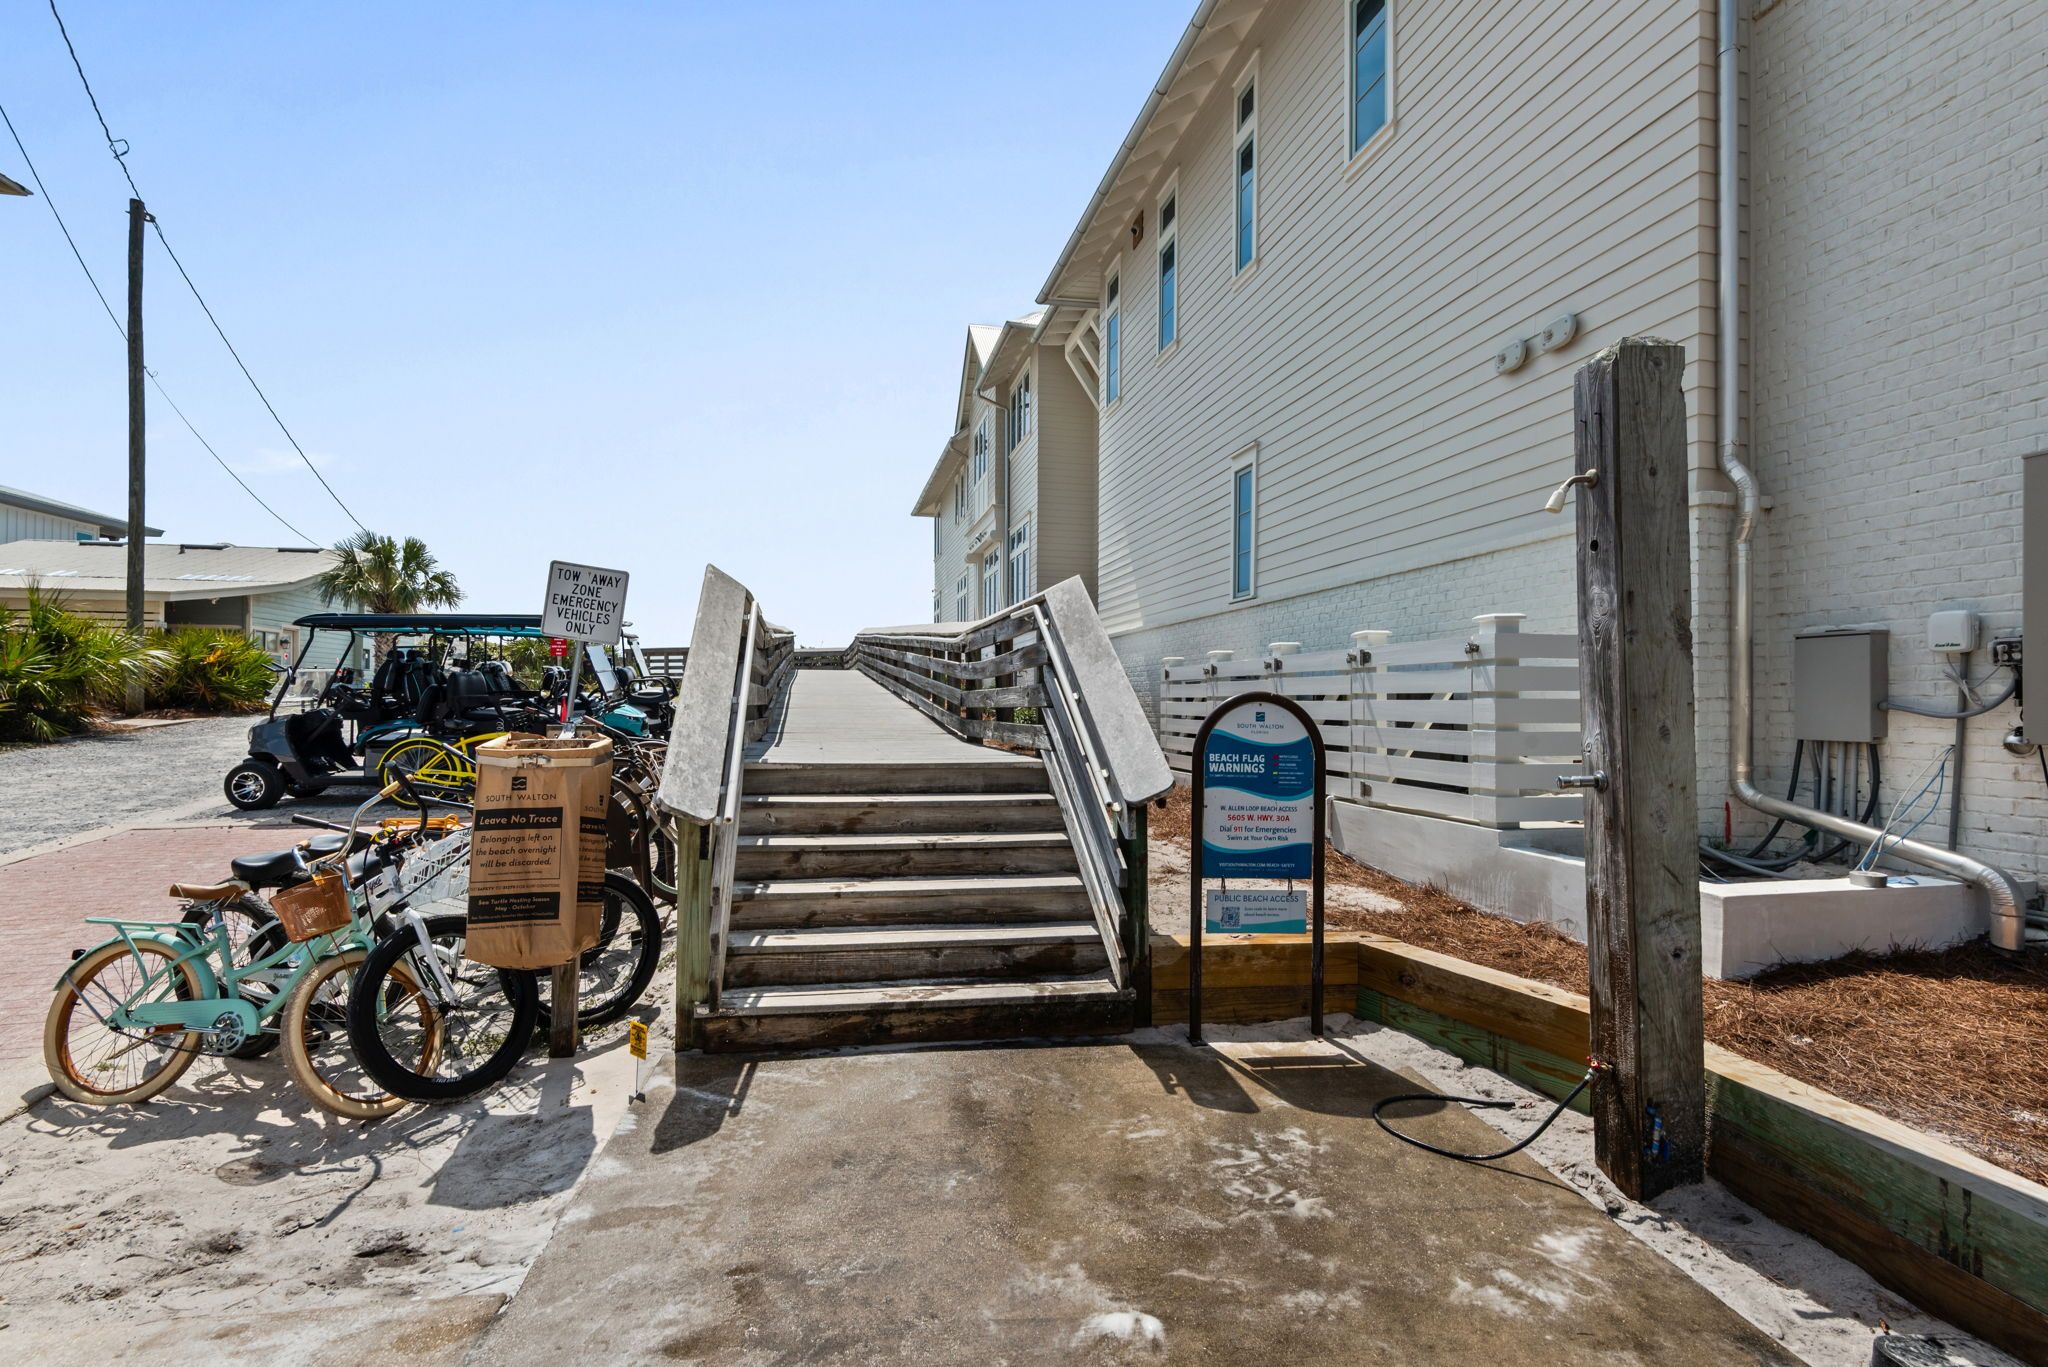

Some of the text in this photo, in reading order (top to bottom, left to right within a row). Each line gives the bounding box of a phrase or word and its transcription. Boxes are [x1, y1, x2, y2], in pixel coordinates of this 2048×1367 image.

[557, 568, 622, 588] TOW AWAY
[572, 583, 602, 598] ZONE
[552, 593, 618, 613] EMERGENCY
[557, 606, 611, 625] VEHICLES
[566, 621, 595, 635] ONLY
[1209, 753, 1265, 763] BEACH FLAG
[1209, 762, 1265, 773] WARNINGS
[486, 793, 557, 803] SOUTH WALTON
[480, 814, 558, 825] Leave No Trace
[1219, 825, 1233, 833] Dial
[1255, 826, 1297, 835] Emergencies
[480, 835, 526, 845] Belongings
[527, 833, 541, 844] left
[476, 844, 557, 857] the beach overnight
[480, 857, 552, 868] will be discarded.
[1214, 894, 1241, 902] PUBLIC
